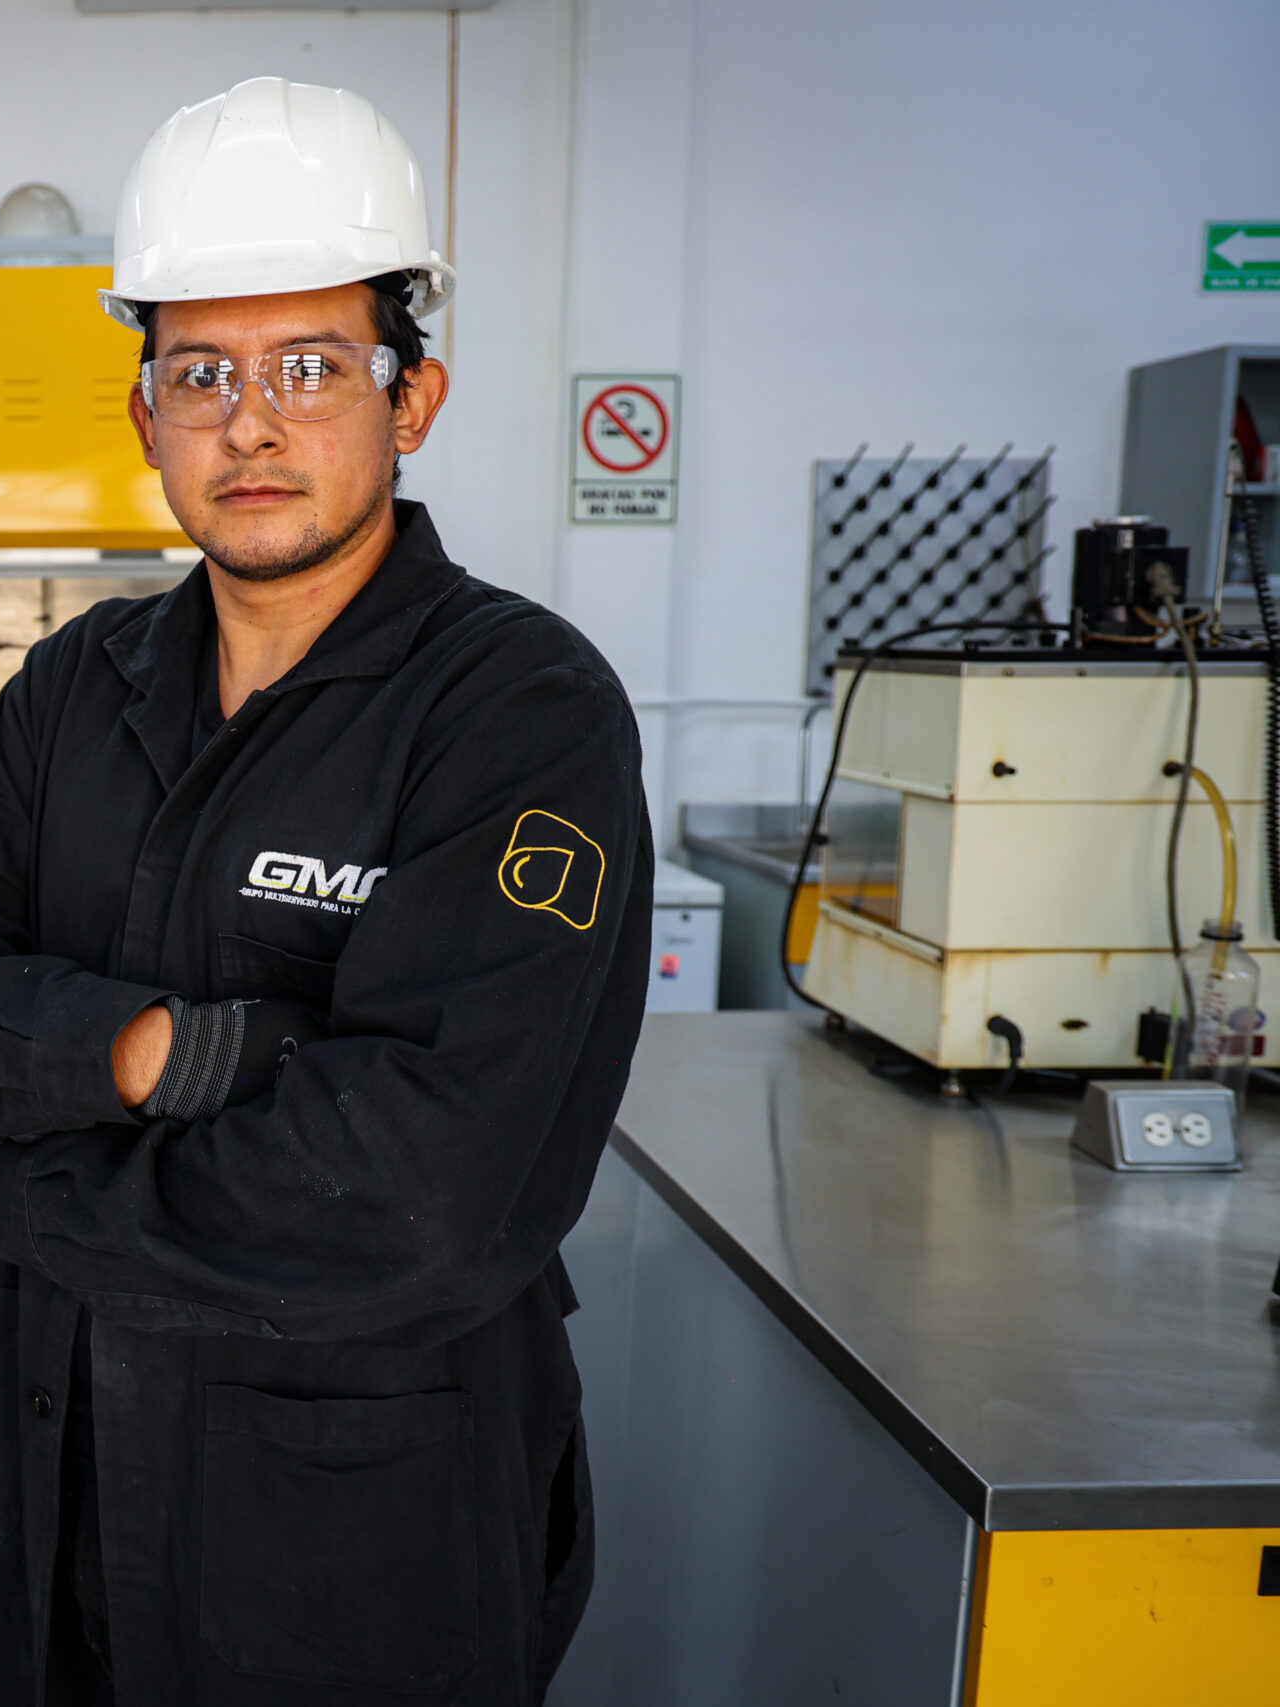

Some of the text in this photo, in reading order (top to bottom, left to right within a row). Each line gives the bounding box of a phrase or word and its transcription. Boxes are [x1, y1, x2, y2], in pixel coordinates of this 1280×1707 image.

[264, 890, 319, 907] MULTISERVICIOS
[320, 901, 339, 913] PARA
[341, 905, 352, 915] LA
